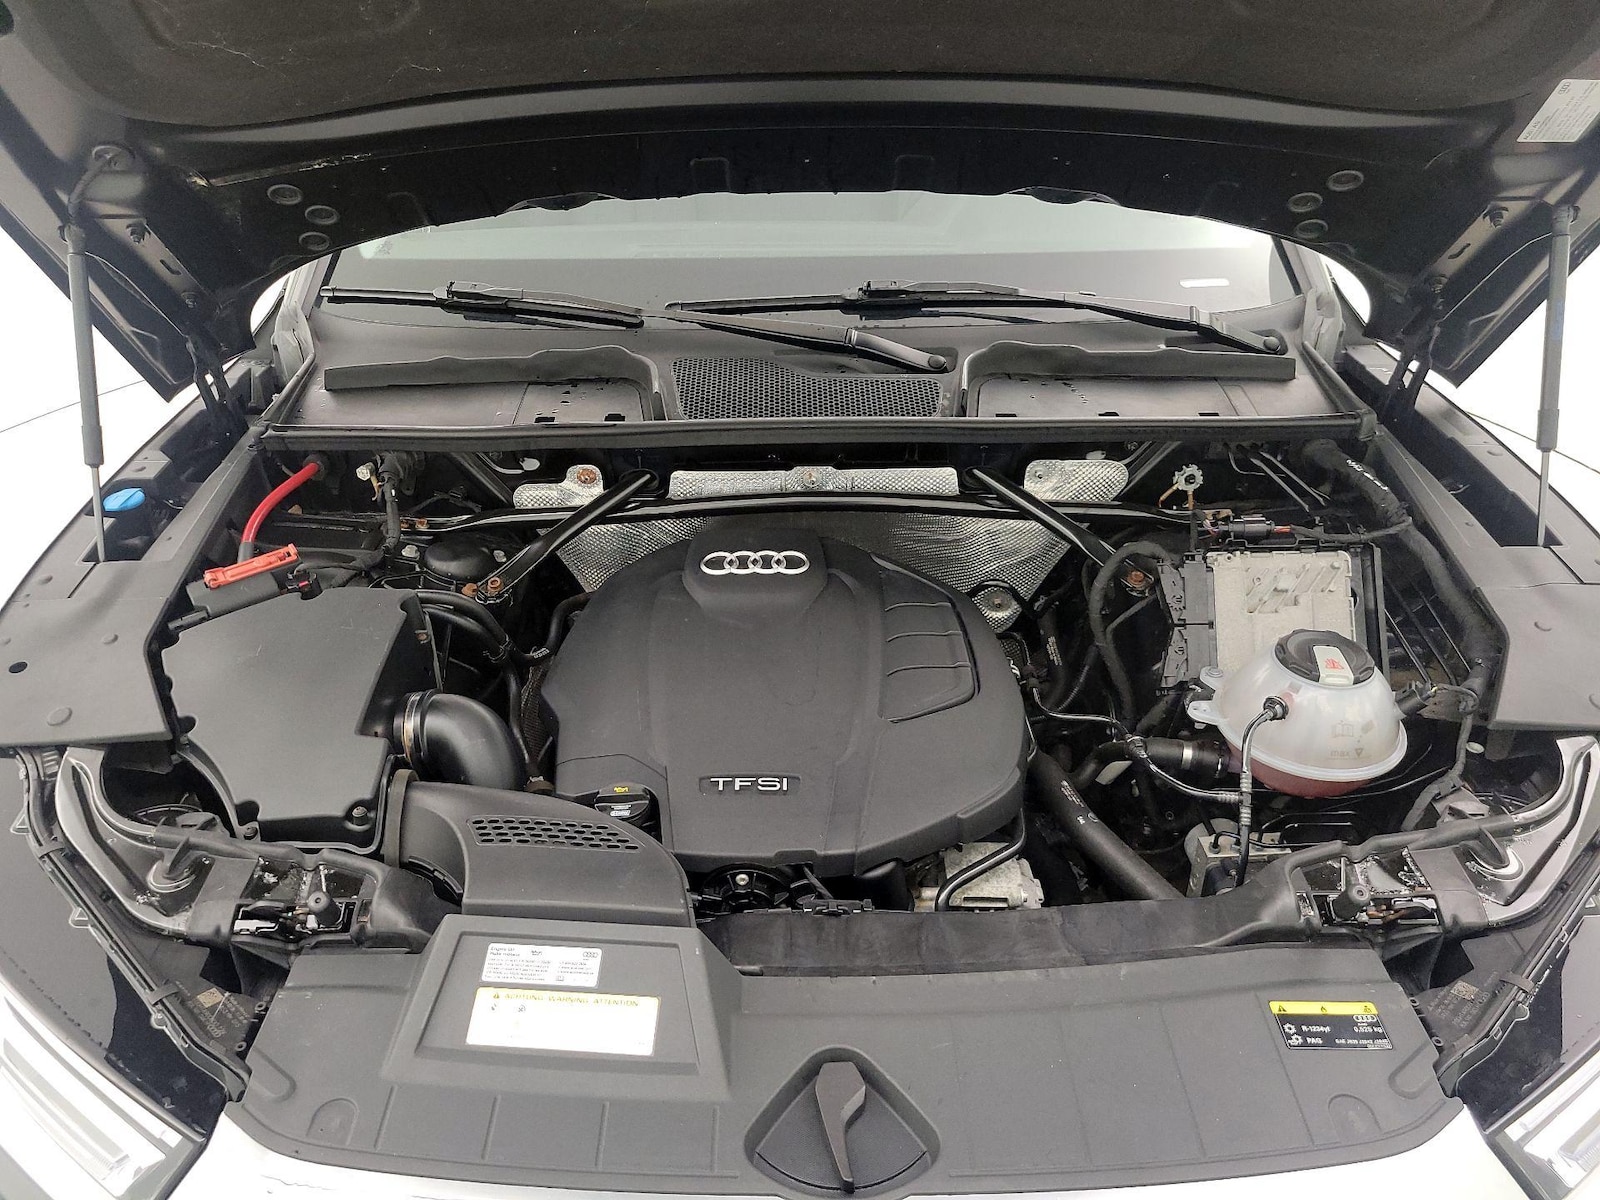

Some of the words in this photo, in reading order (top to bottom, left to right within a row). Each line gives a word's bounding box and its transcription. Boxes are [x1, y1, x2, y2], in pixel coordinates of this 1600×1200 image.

[710, 777, 788, 791] TFSI
[504, 993, 544, 1001] ACHTUNG
[548, 995, 589, 1004] WARNING
[593, 998, 640, 1007] ATTENTION
[1374, 1026, 1383, 1034] kg
